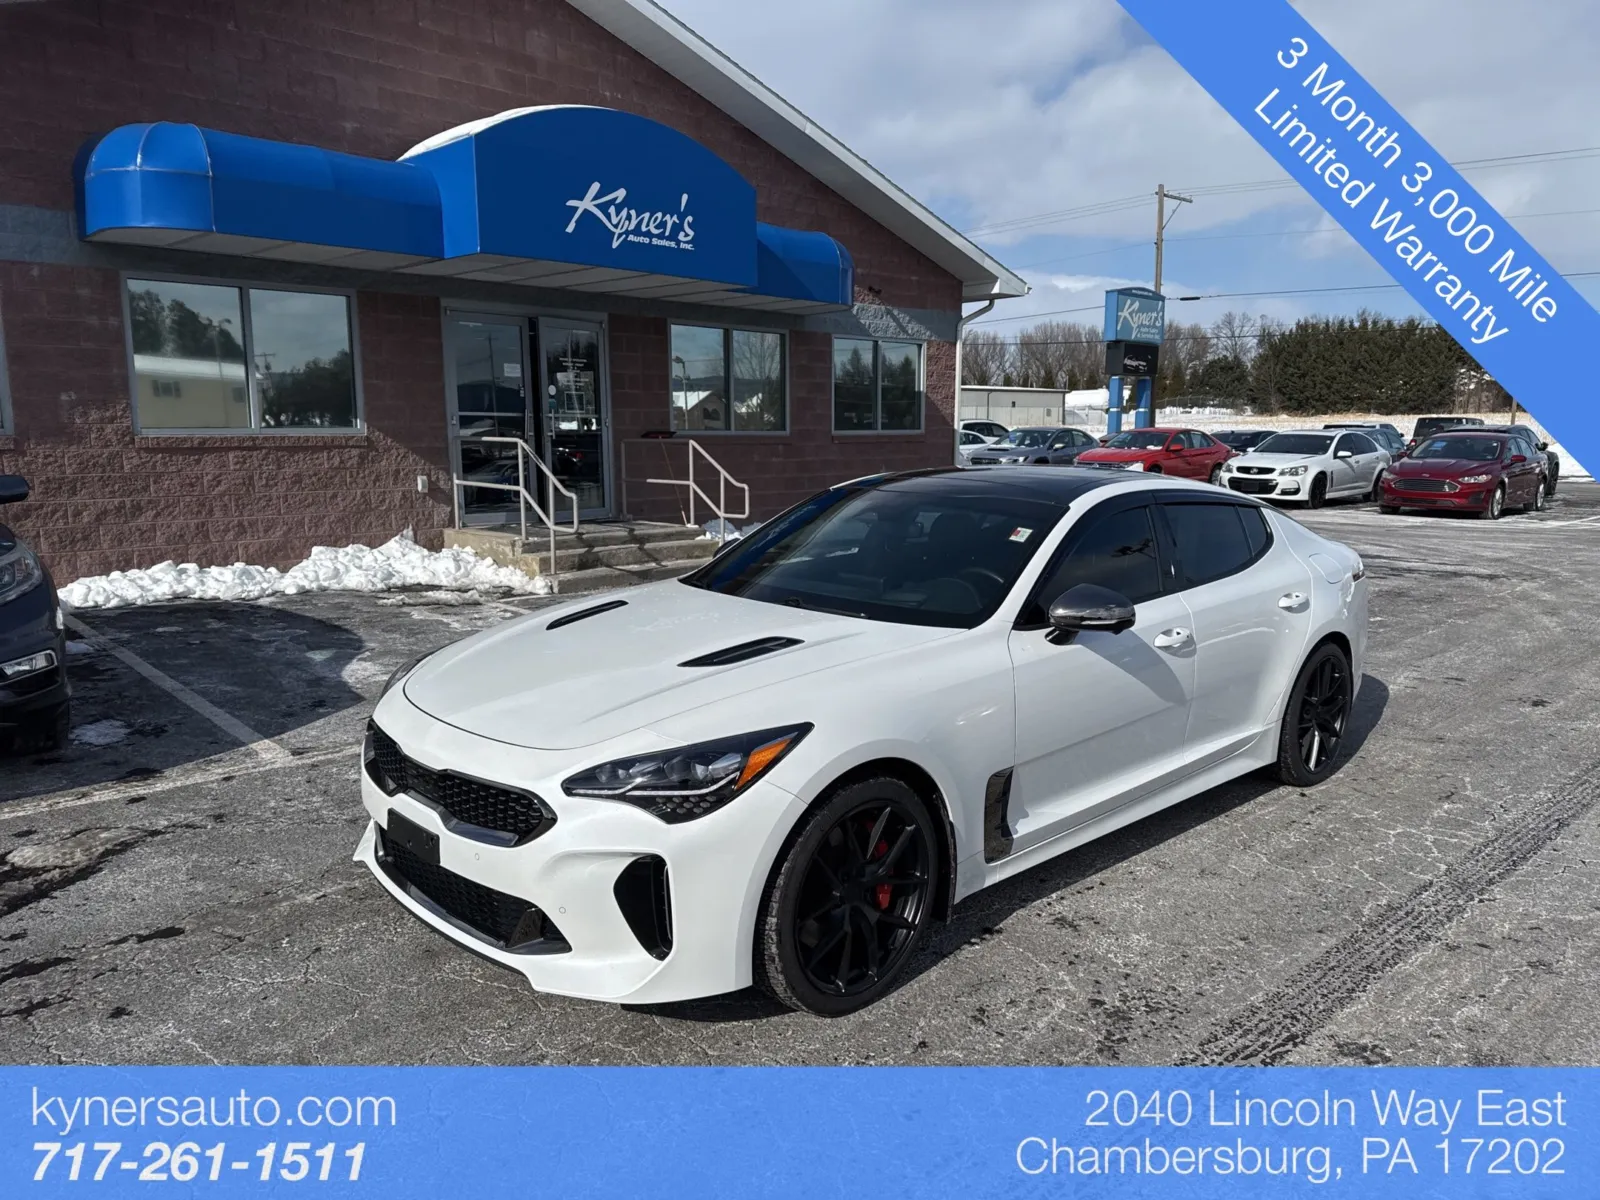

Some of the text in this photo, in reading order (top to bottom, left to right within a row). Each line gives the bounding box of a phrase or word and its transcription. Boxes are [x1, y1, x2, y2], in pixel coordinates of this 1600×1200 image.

[565, 181, 695, 249] Kyner's
[627, 234, 650, 244] Auto
[680, 242, 695, 250] Inc.
[1117, 299, 1162, 339] Kyner's
